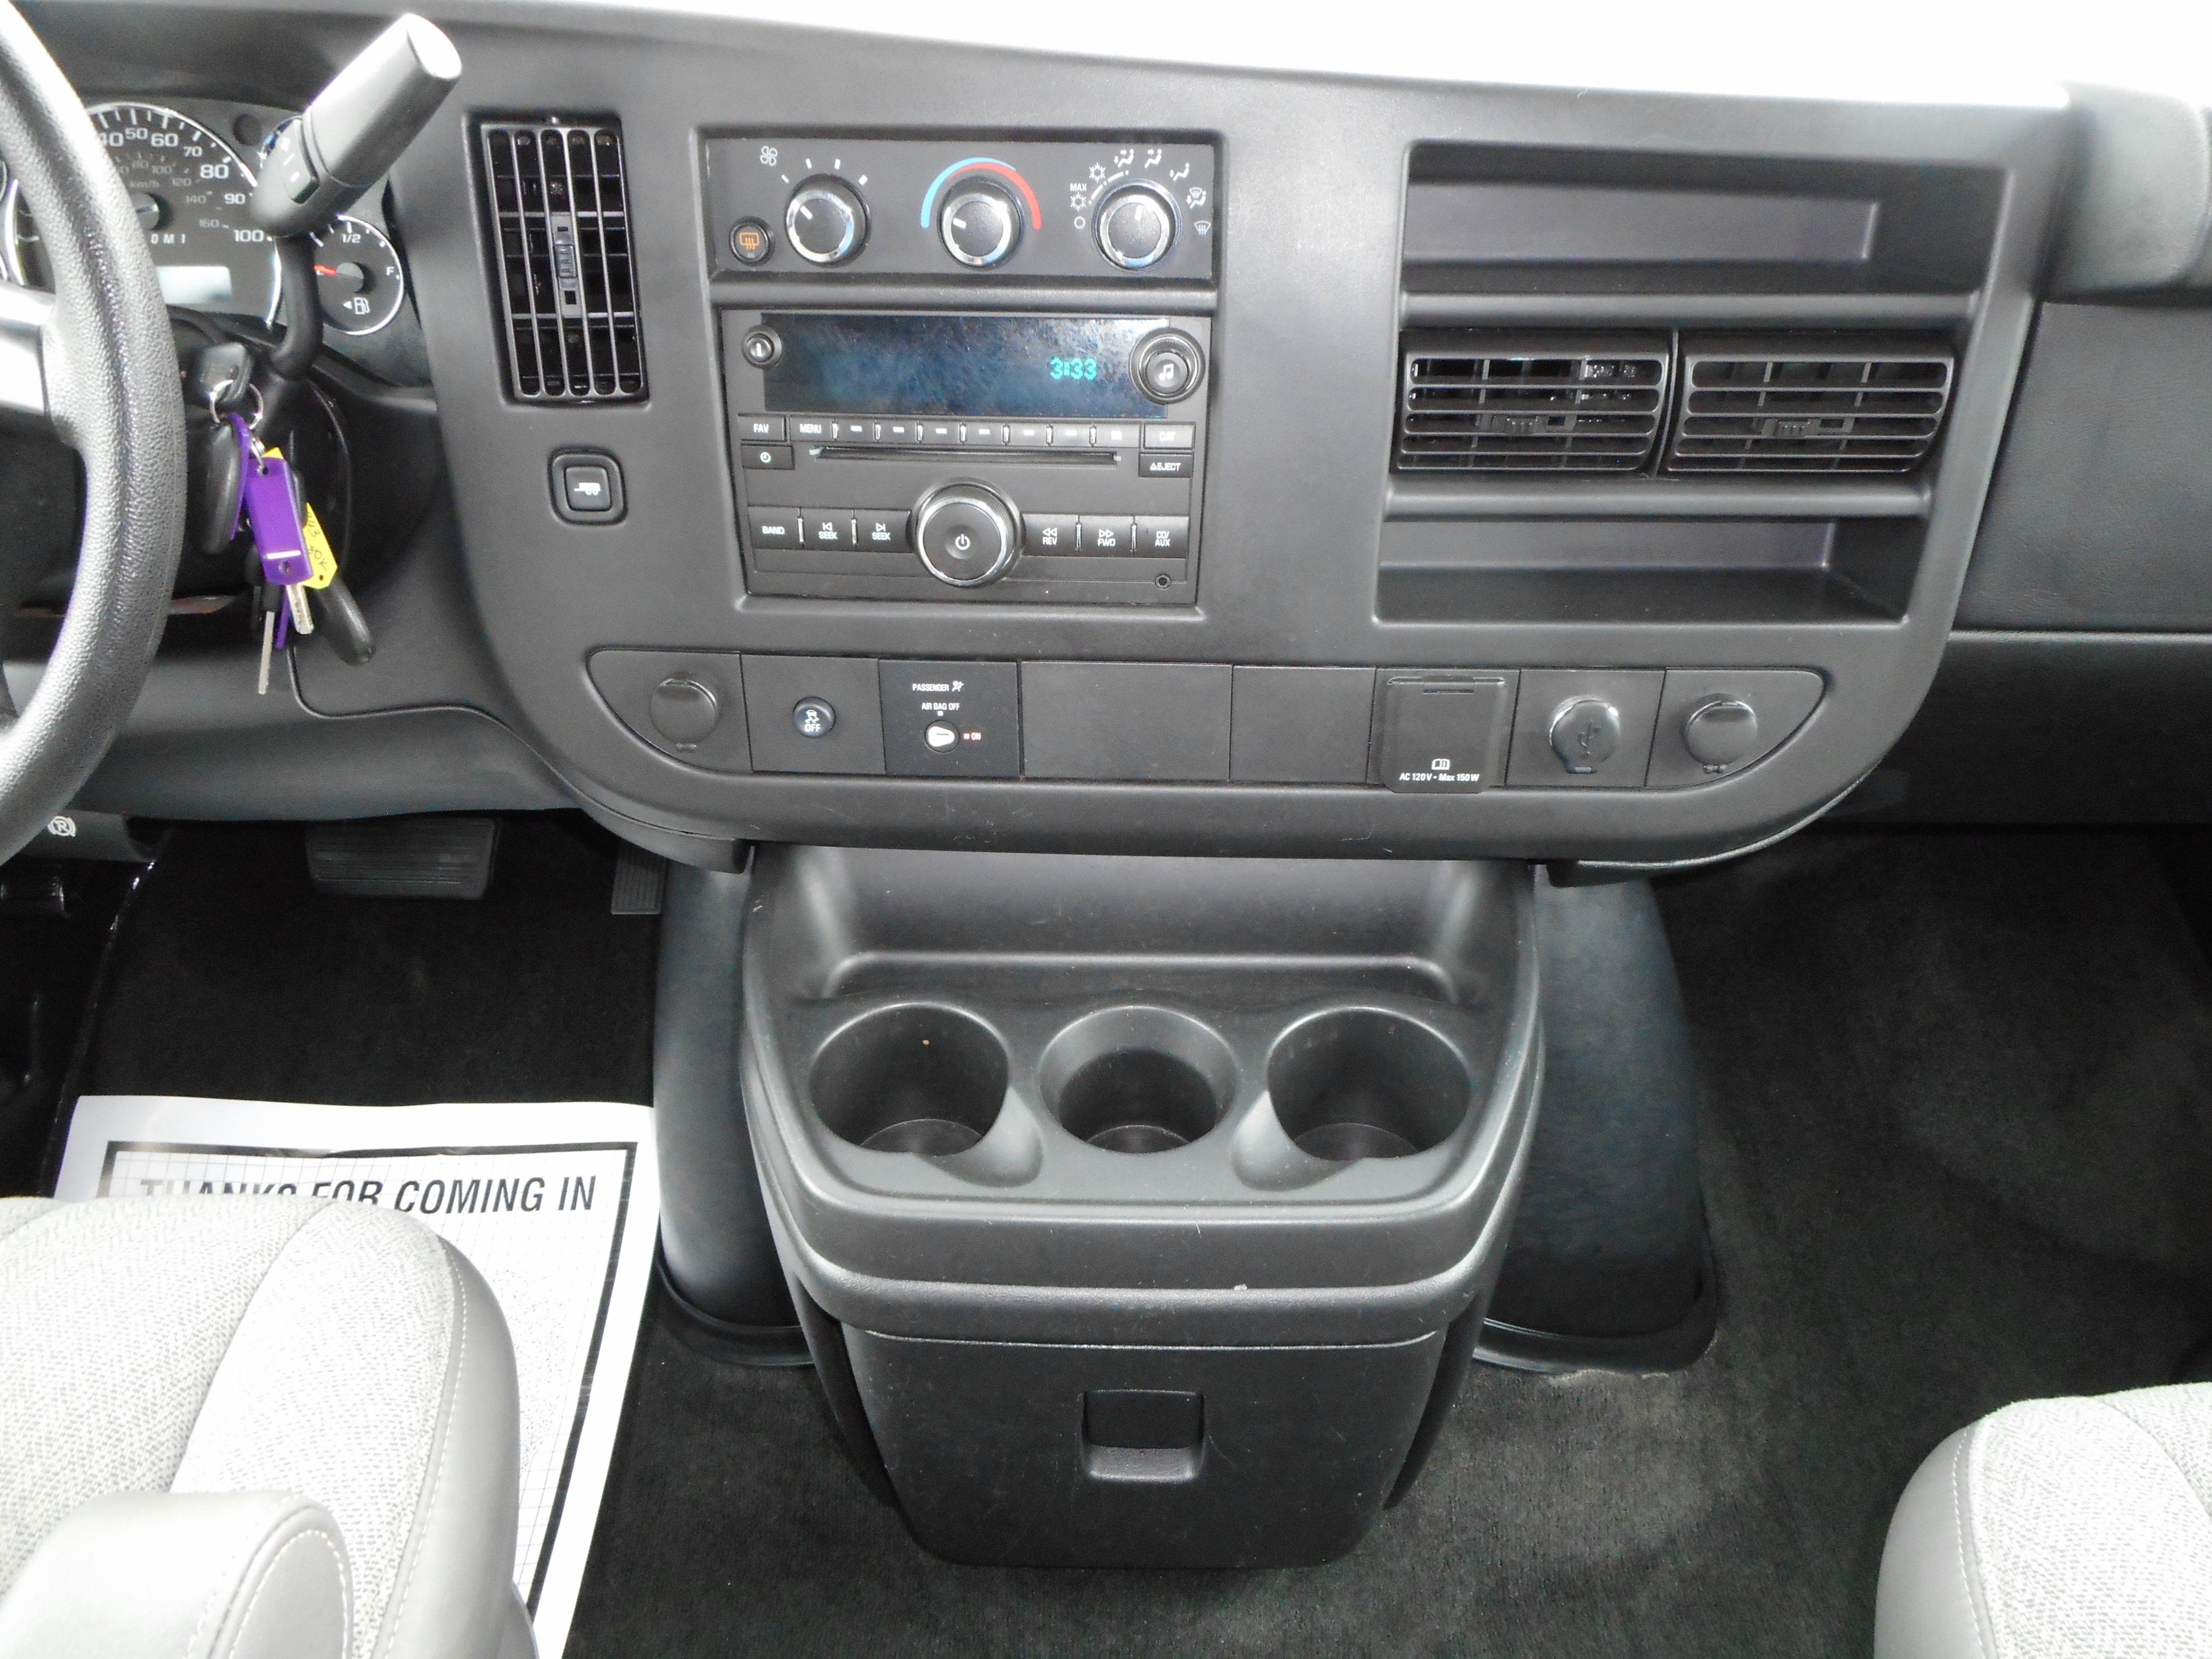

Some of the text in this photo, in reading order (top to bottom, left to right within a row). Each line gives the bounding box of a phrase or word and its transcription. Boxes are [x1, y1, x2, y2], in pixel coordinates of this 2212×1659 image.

[125, 128, 148, 140] 50
[151, 133, 179, 147] 60
[183, 146, 202, 157] 70
[200, 164, 229, 179] 80
[1070, 183, 1087, 191] MAX
[185, 195, 207, 204] 140
[224, 193, 246, 204] 90
[234, 229, 264, 242] 100
[342, 234, 361, 243] 1/2
[386, 267, 394, 276] F
[1050, 357, 1097, 380] 3:33
[754, 423, 769, 433] FAV
[799, 423, 822, 434] MENU
[1159, 431, 1176, 441] CAT
[1157, 462, 1181, 472] EJECT
[762, 526, 785, 535] BAND
[818, 531, 838, 540] SEEK
[872, 531, 891, 541] SEEK
[1042, 537, 1057, 545] REV
[1097, 538, 1116, 547] FWD
[1155, 538, 1170, 547] AUX
[912, 684, 949, 692] PASSENGER
[805, 723, 821, 732] OFF
[312, 1180, 383, 1205] FOR
[395, 1177, 546, 1214] COMING
[558, 1176, 596, 1211] IN
